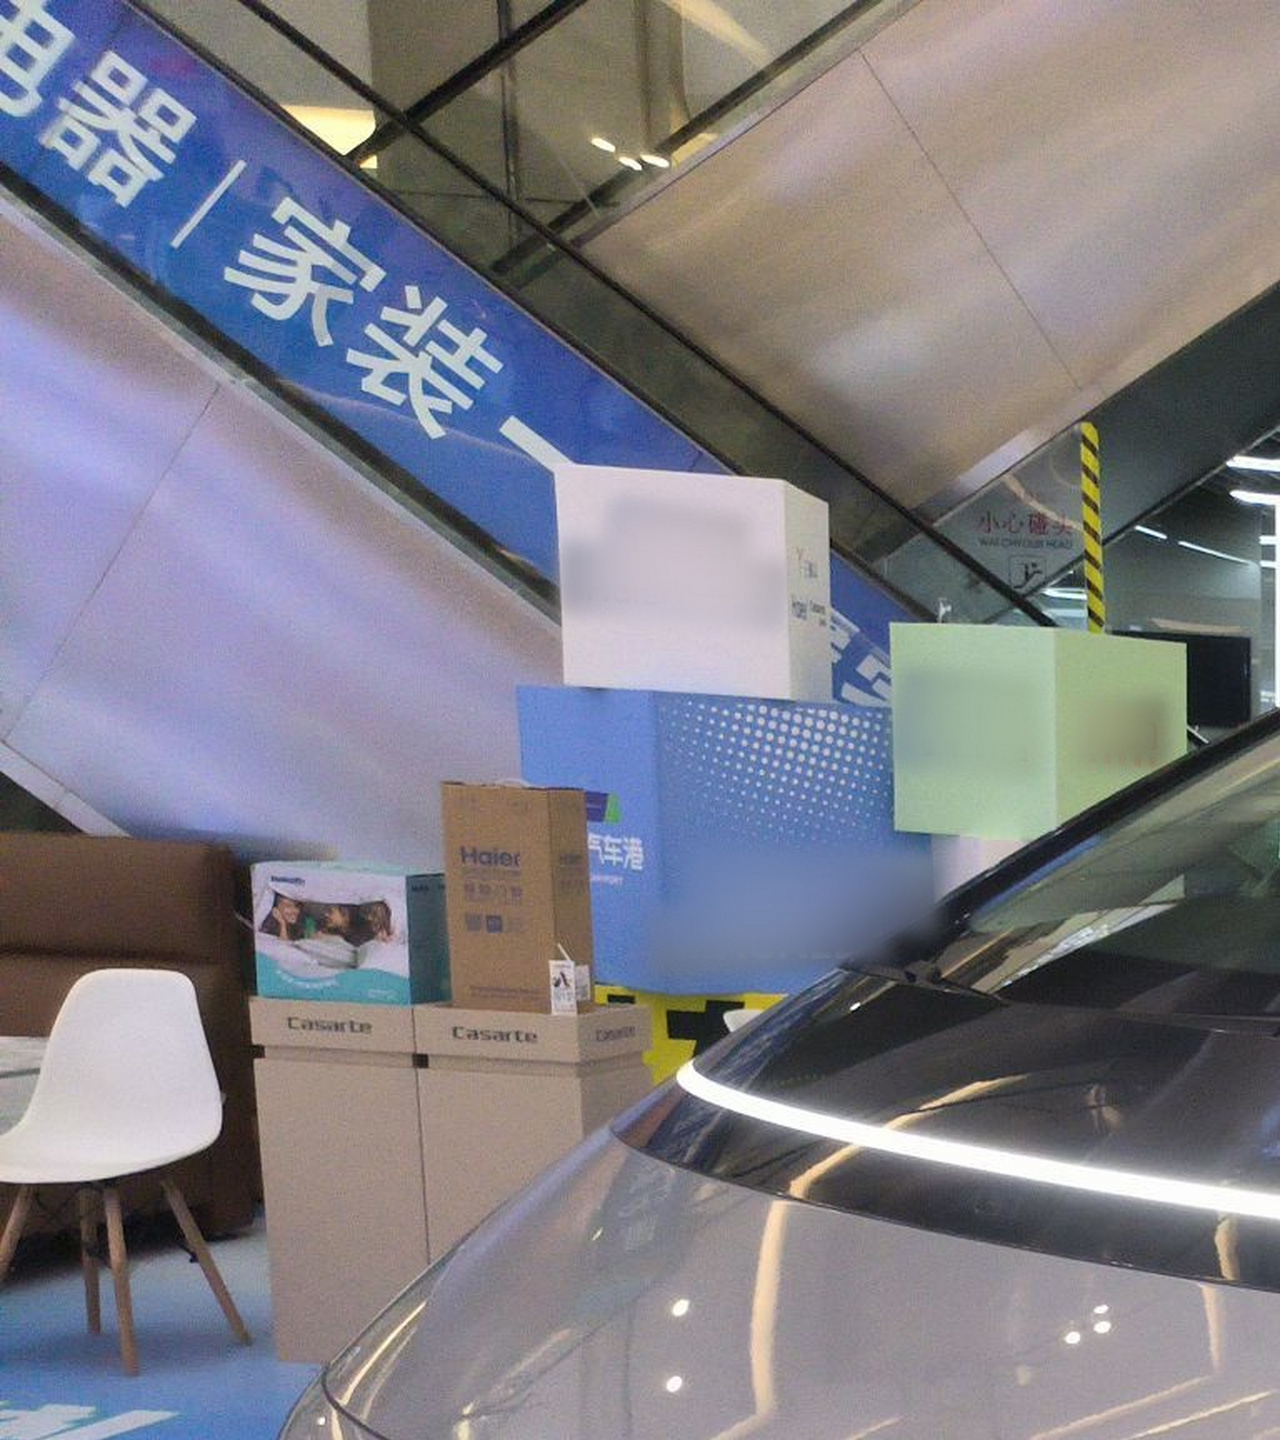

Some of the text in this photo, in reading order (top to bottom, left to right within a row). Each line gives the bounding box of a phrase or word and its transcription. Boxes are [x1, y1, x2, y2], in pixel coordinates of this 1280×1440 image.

[978, 510, 1074, 536] 小心碰头
[287, 1015, 372, 1034] Casarte
[452, 1025, 538, 1043] Casarte
